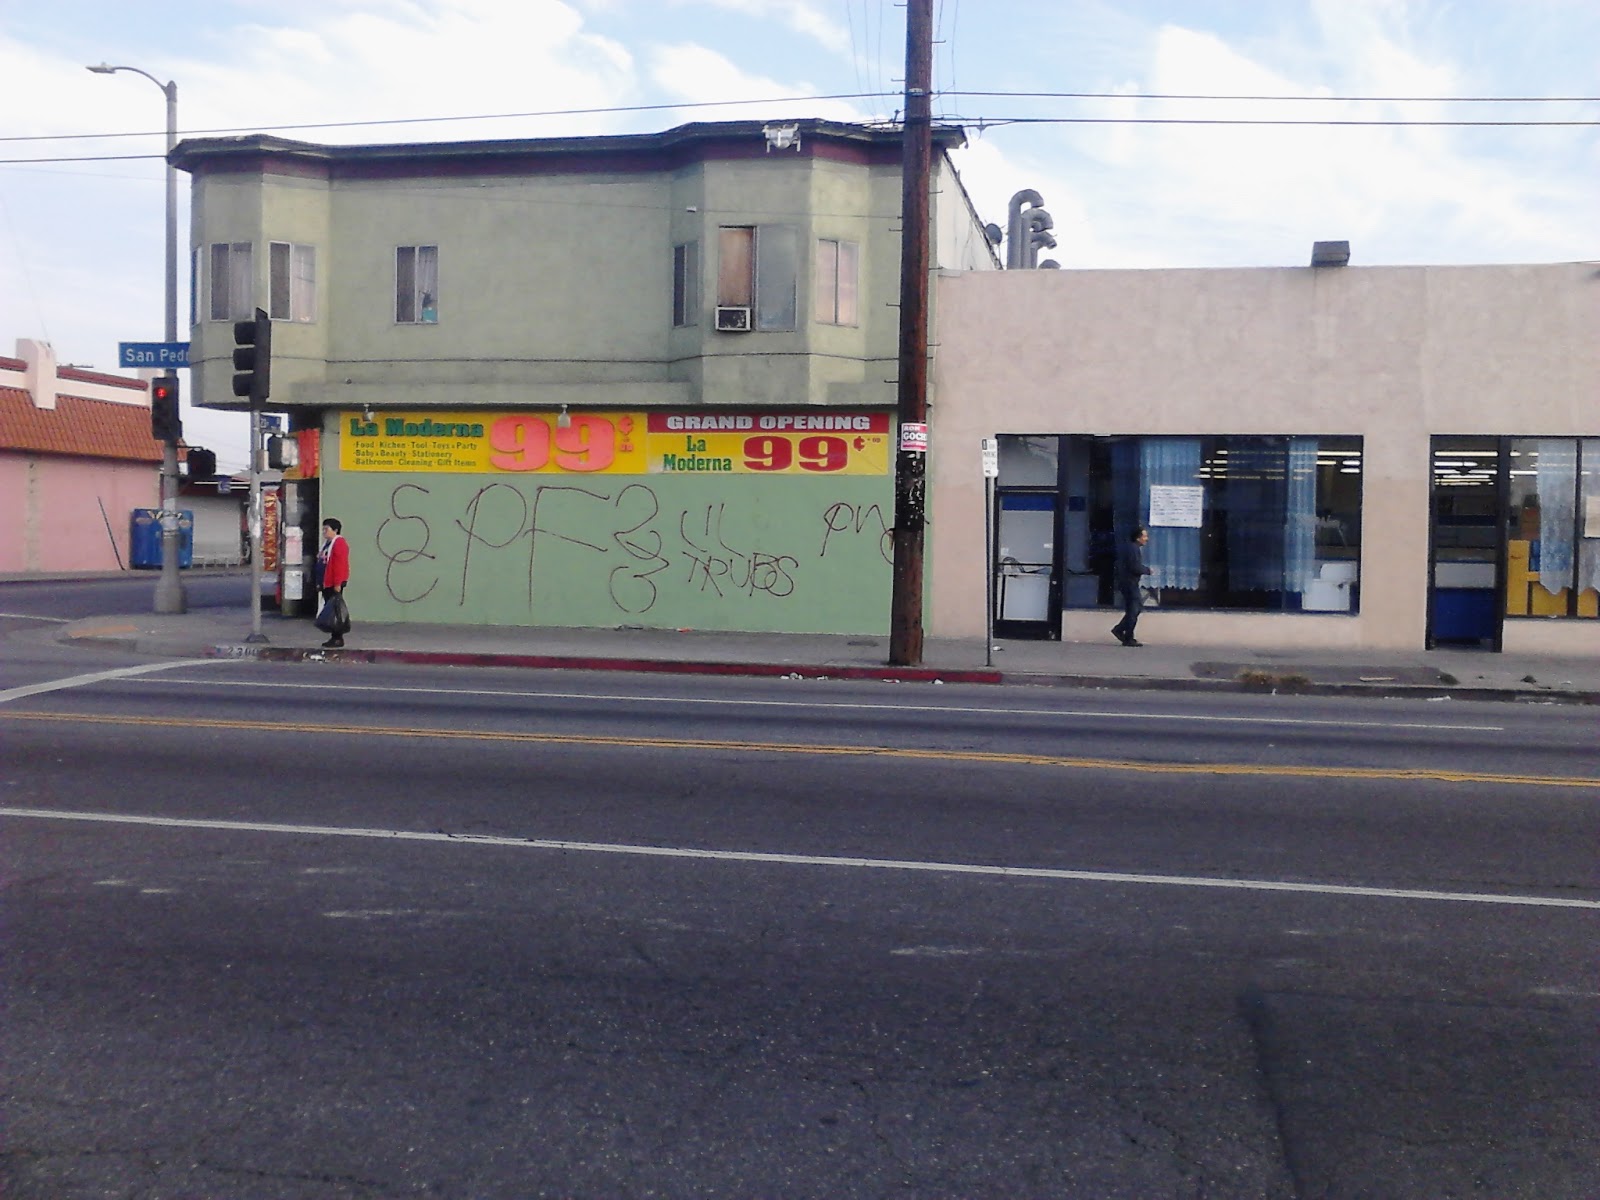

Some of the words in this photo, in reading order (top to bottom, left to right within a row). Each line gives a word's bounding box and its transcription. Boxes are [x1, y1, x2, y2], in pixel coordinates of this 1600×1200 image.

[126, 348, 154, 362] San
[350, 418, 379, 436] La
[385, 418, 484, 437] Moderna
[667, 415, 753, 430] GRAND
[760, 416, 870, 430] OPENING
[432, 442, 450, 450] Toys
[456, 441, 477, 450] Party
[686, 435, 706, 452] La
[355, 449, 374, 458] Baby
[380, 449, 406, 458] Beauty
[412, 450, 453, 459] Stationery
[355, 458, 394, 466] Bathroom
[398, 459, 433, 467] Cleaning
[437, 458, 452, 466] Gift
[454, 459, 477, 467] Items
[662, 454, 733, 472] Moderna
